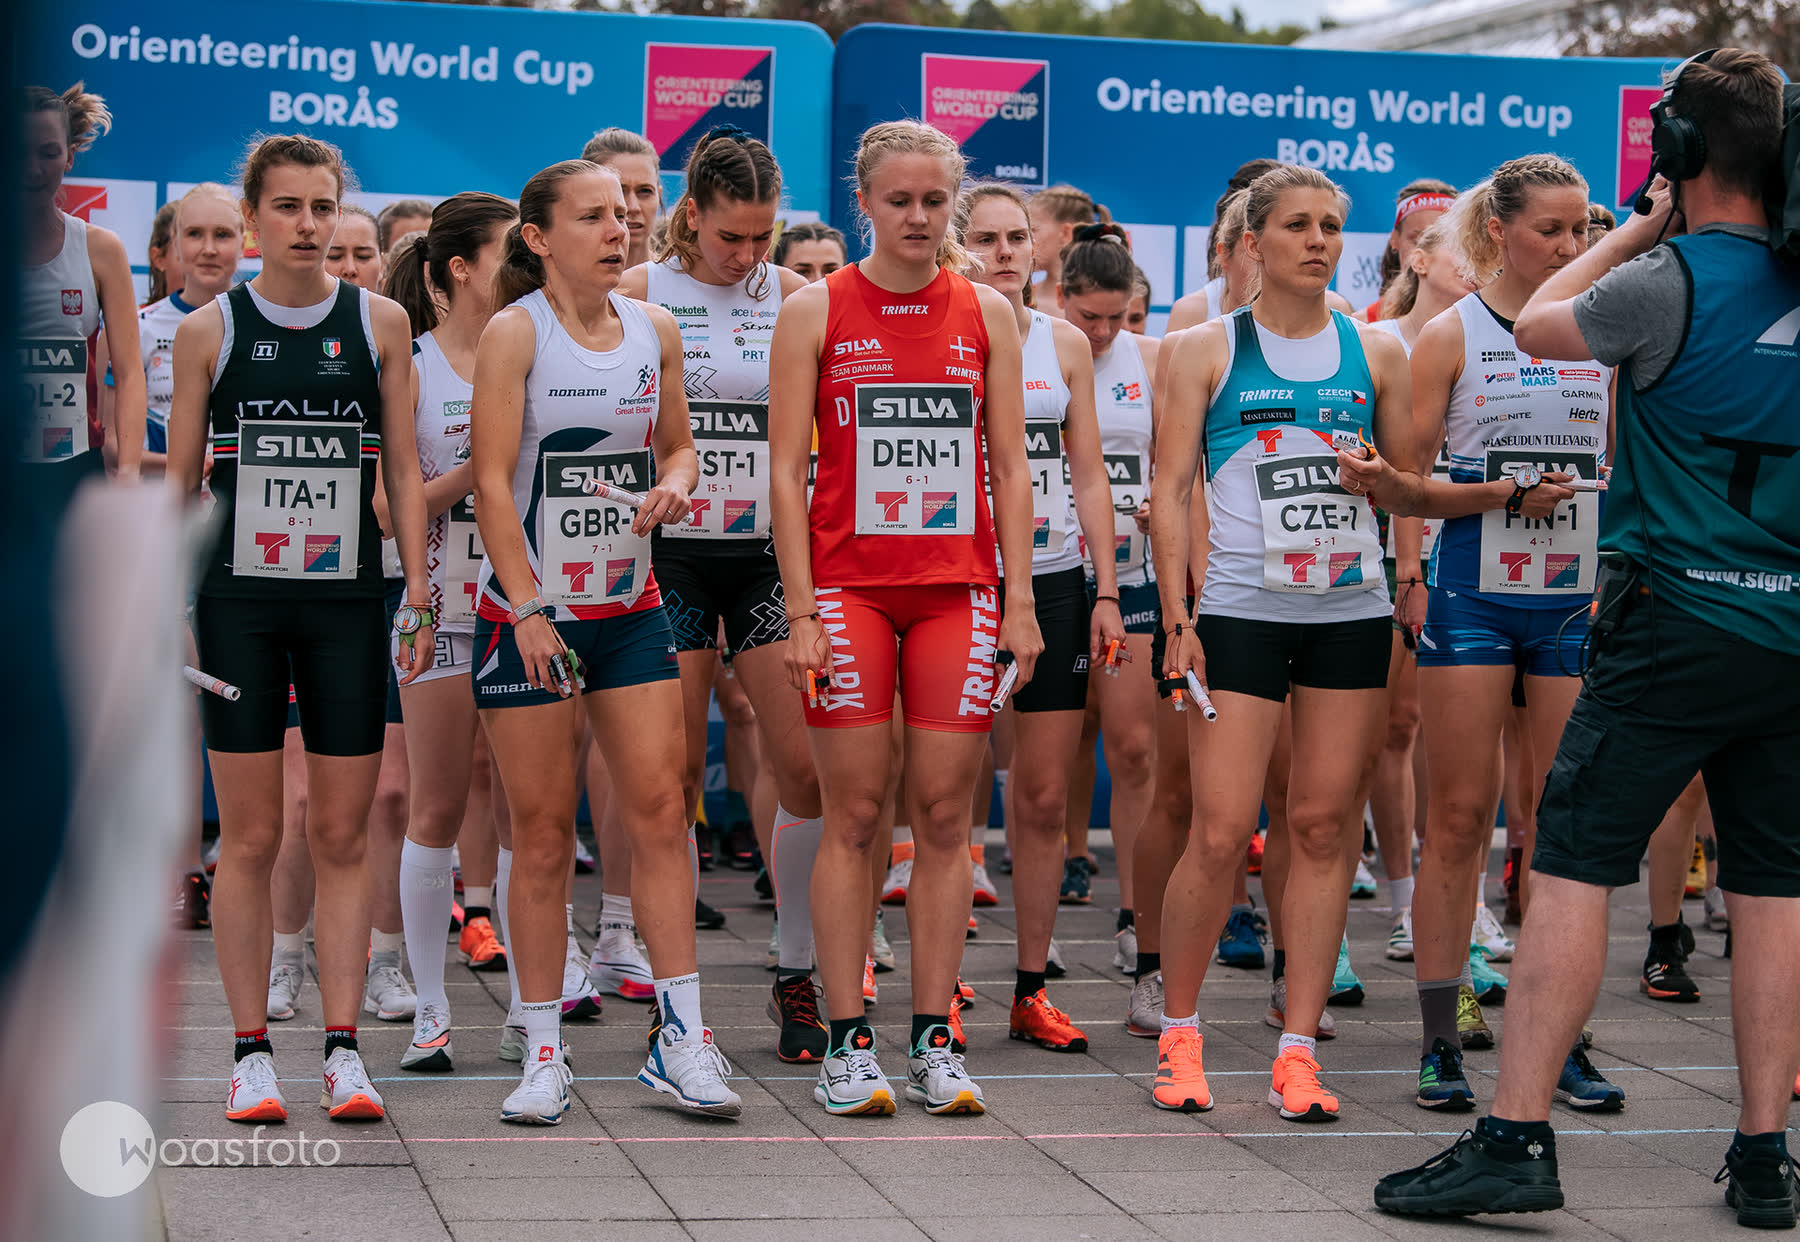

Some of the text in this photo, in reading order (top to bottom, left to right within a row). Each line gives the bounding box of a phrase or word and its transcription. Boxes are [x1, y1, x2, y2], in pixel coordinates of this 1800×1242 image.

[72, 23, 594, 95] Orienteering World Cup
[655, 75, 763, 93] ORIENTEERING
[654, 90, 763, 109] WORLD CUP
[932, 87, 1039, 105] ORIENTEERING
[269, 86, 399, 130] BORÅS
[932, 101, 1038, 121] WORLD CUP
[1097, 77, 1572, 137] Orienteering World Cup
[1277, 133, 1395, 174] BORÅS
[672, 305, 708, 315] Hekotek
[731, 308, 749, 317] ace
[881, 305, 929, 315] TRIMTEX
[742, 350, 765, 360] PRT
[834, 338, 883, 356] SILVA
[1754, 348, 1798, 358] INTERNATIONAL
[831, 363, 894, 378] TEAM DANMARK
[945, 366, 981, 381] TRIMTEX
[1520, 366, 1556, 377] MARS
[1025, 380, 1052, 390] BEL
[1521, 376, 1558, 387] MARS
[548, 388, 607, 397] noname
[1240, 389, 1294, 403] TRIMTEX
[1317, 388, 1352, 397] CZECH
[1562, 390, 1603, 401] GARMIN
[238, 400, 364, 418] ITALIA
[615, 406, 634, 416] Great
[873, 398, 959, 419] SILVA
[1569, 407, 1600, 421] Hertz
[689, 411, 760, 433] SILVA
[256, 435, 347, 459] SILVA
[873, 439, 960, 467] DEN-1
[698, 450, 755, 478] ST-1
[561, 463, 638, 488] SILVA
[1272, 465, 1341, 491] SILV
[264, 478, 337, 509] ITA-1
[1280, 504, 1358, 533] CZE-1
[1124, 610, 1156, 626] ANCE
[958, 583, 997, 716] TRIMTE
[670, 976, 699, 987] nona
[521, 1003, 557, 1012] oname
